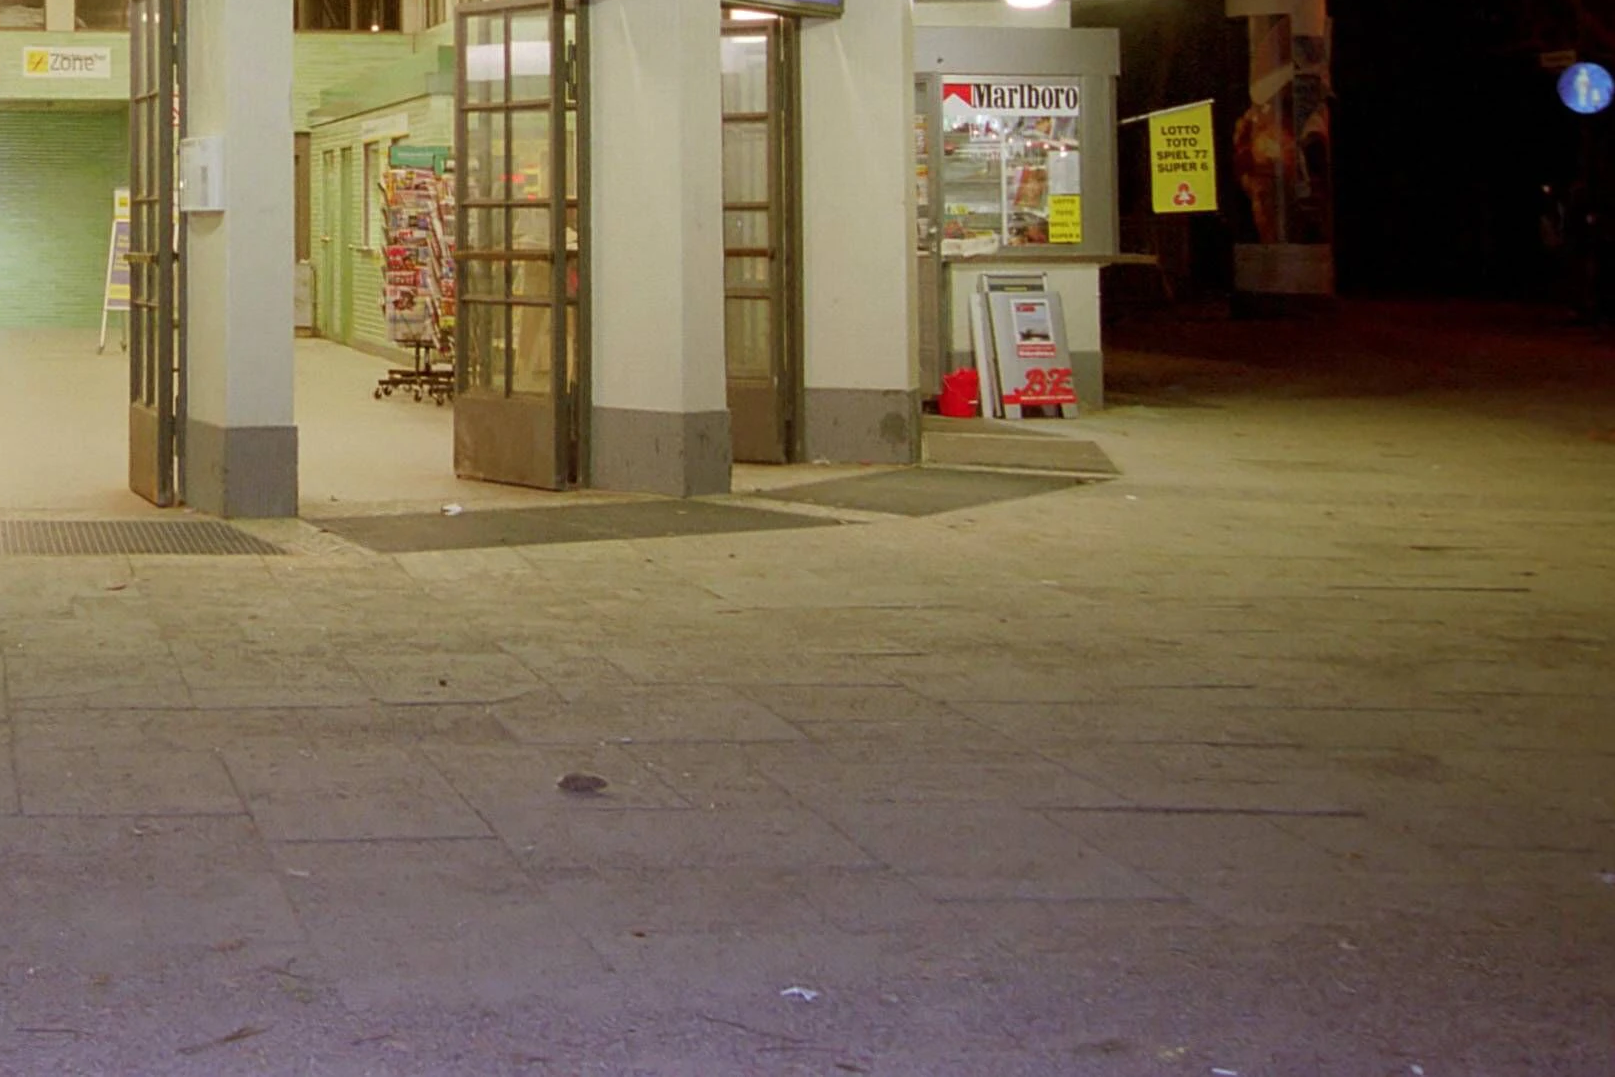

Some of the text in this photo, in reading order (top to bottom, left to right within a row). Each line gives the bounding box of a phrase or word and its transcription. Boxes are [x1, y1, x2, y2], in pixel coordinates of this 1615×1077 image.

[972, 83, 1078, 110] Marlboro
[1160, 125, 1201, 136] LOTTO
[1165, 137, 1198, 148] TOTO
[1156, 150, 1190, 161] SPIEL
[1157, 162, 1197, 173] SUPER
